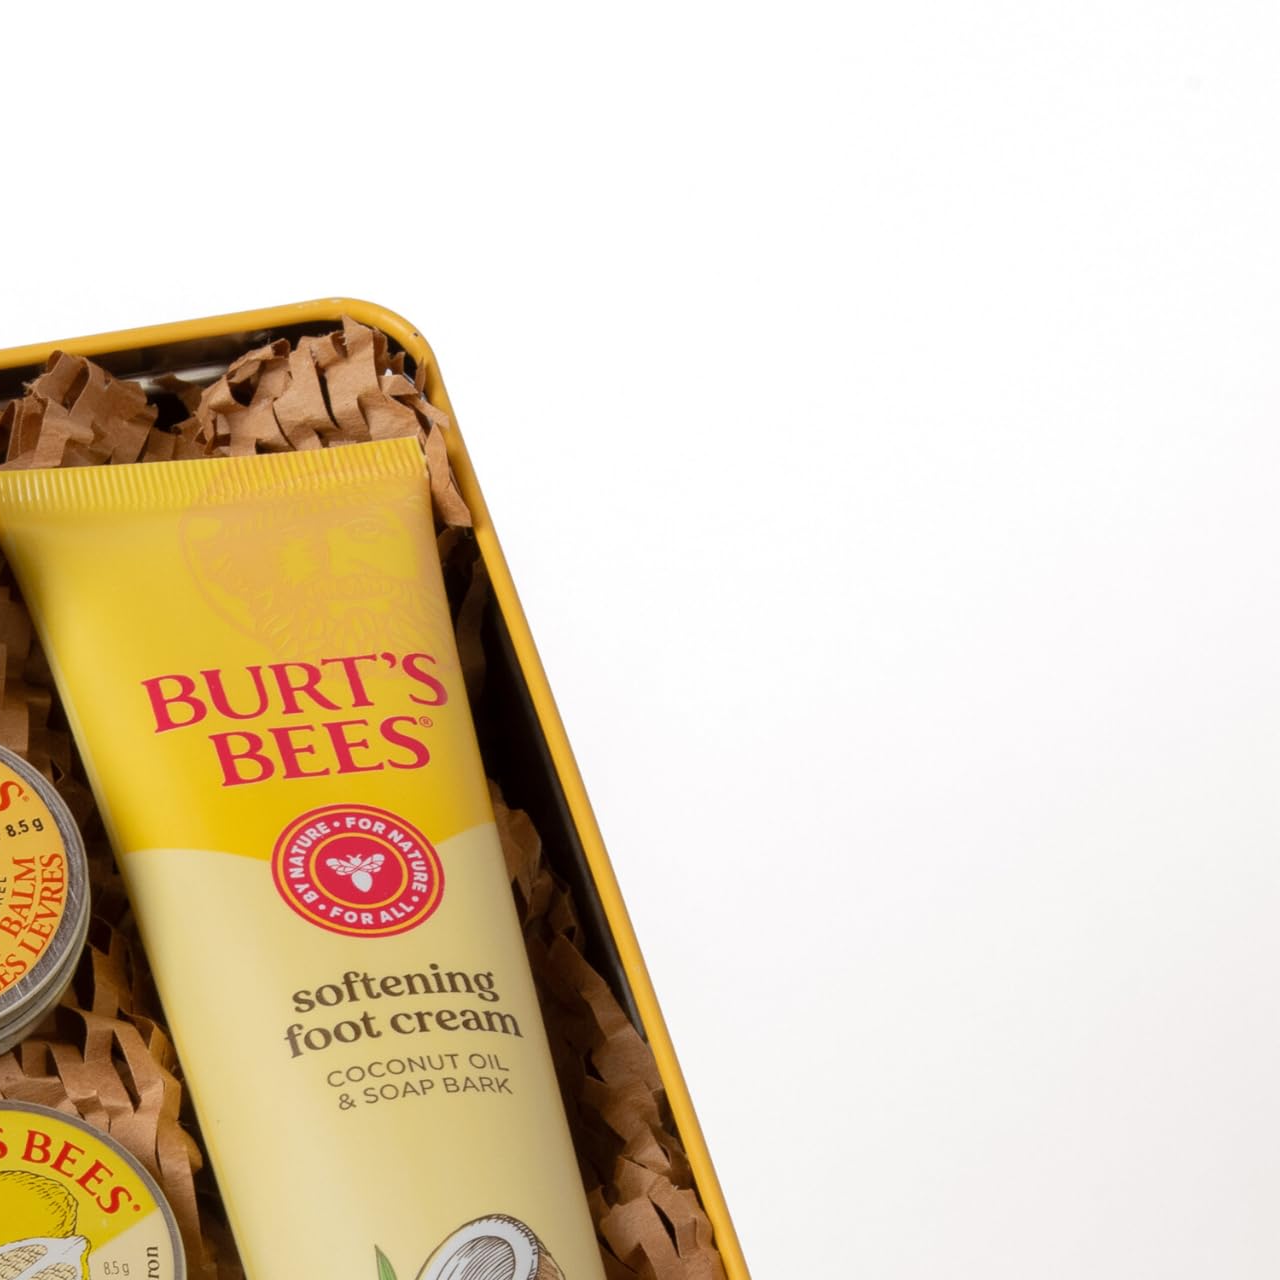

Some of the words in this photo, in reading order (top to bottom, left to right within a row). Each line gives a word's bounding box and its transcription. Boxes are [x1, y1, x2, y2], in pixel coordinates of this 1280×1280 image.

[140, 652, 448, 734] BURT'S
[6, 819, 31, 838] 8.5
[33, 816, 44, 832] g
[289, 821, 331, 879] NATURE
[345, 816, 386, 834] FOR
[387, 829, 428, 893] NATURE
[293, 882, 320, 904] BY
[329, 906, 374, 925] FOR
[380, 902, 415, 923] ALL
[291, 962, 500, 1014] softening
[284, 1005, 383, 1060] foot
[389, 1005, 524, 1039] cream
[326, 1053, 460, 1089] COCONUT
[468, 1053, 510, 1073] OIL
[337, 1092, 357, 1111] &
[361, 1079, 435, 1105] SOAP
[443, 1076, 514, 1096] BARK
[21, 1129, 132, 1215] BEES
[103, 1261, 121, 1276] 8.5
[122, 1263, 130, 1276] g
